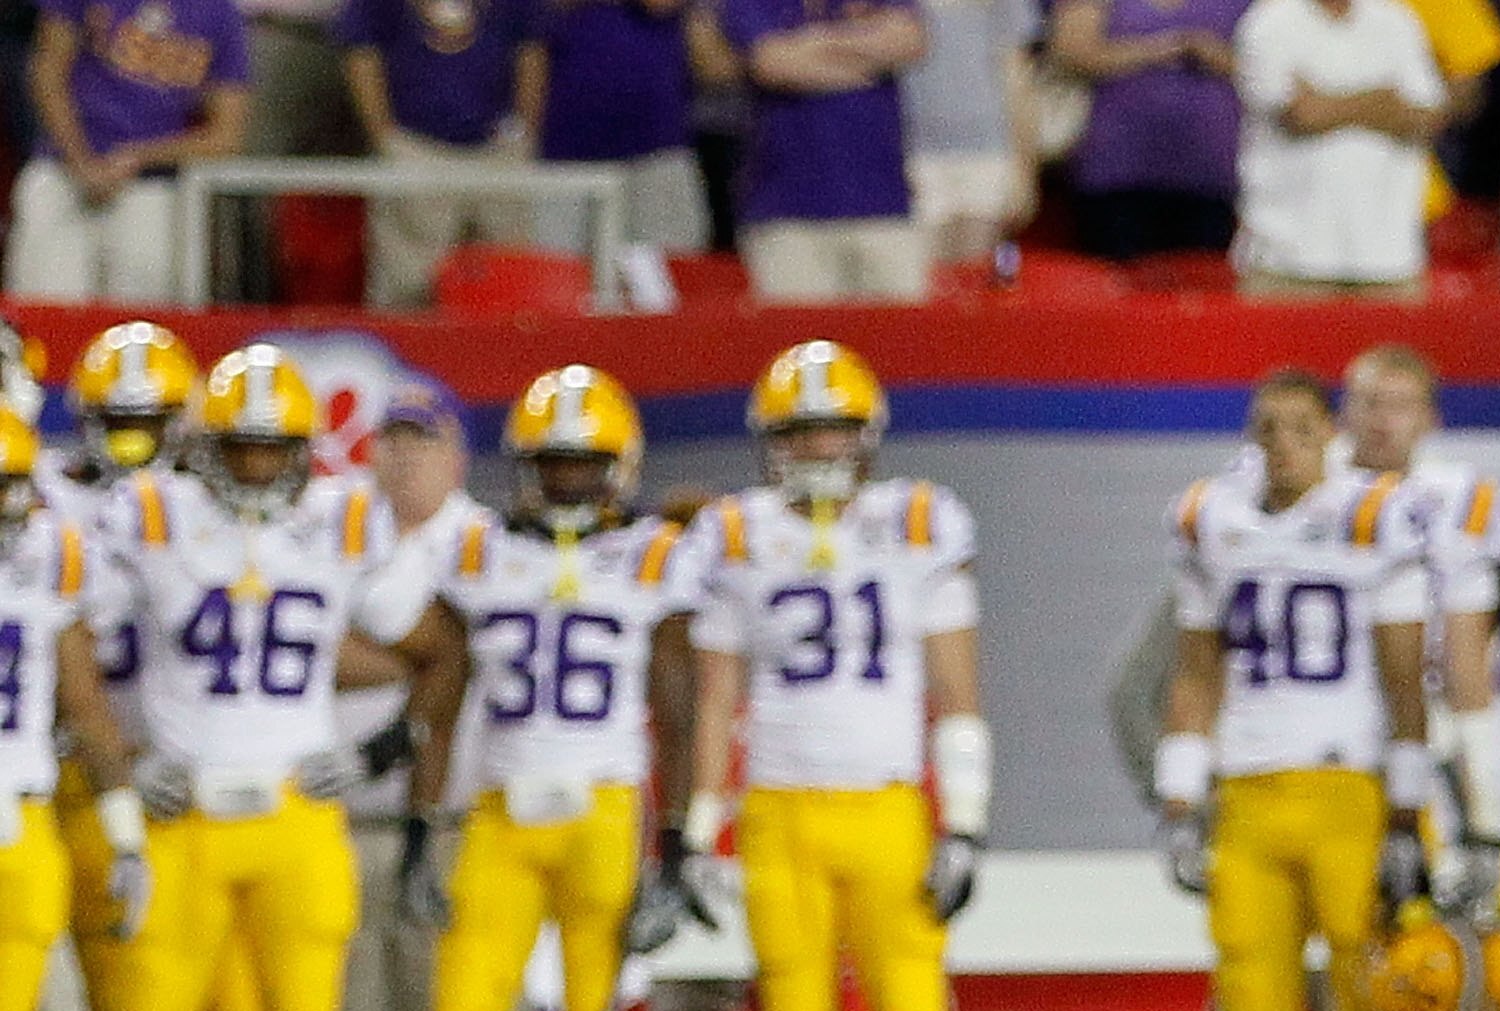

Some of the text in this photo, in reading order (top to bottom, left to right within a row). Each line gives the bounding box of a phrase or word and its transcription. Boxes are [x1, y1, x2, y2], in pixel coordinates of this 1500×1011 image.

[182, 586, 326, 696] 46
[486, 610, 623, 721] 36
[768, 582, 886, 681] 31
[1219, 579, 1349, 688] 40
